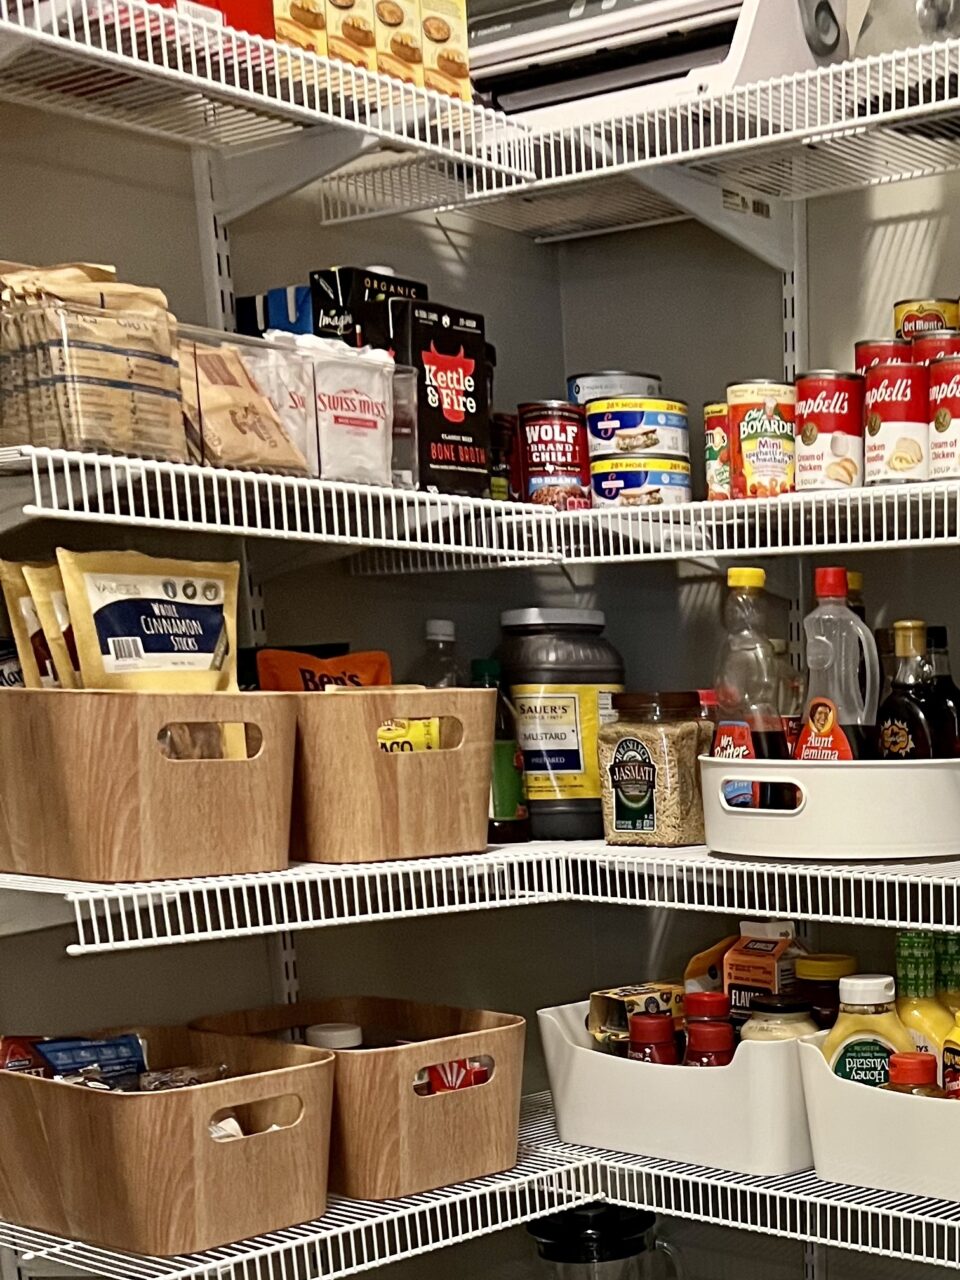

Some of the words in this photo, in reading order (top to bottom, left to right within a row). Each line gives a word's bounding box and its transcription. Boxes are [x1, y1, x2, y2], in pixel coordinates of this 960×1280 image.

[364, 277, 417, 299] ORGANIC
[916, 319, 943, 331] Monte
[424, 364, 475, 393] Kettle
[427, 386, 439, 408] &
[441, 388, 477, 414] Fire
[745, 408, 764, 421] Chef
[525, 424, 578, 444] WOLF
[530, 443, 574, 452] BRAND
[758, 439, 782, 450] Mini
[949, 439, 957, 449] of
[431, 442, 456, 461] BONE
[458, 444, 486, 464] BROTH
[531, 451, 573, 463] CHILI
[815, 452, 824, 462] of
[140, 615, 204, 636] CINNAMON
[170, 635, 199, 652] STICKS
[519, 703, 570, 715] SAUER'S
[523, 731, 568, 742] MUSTARD
[807, 731, 835, 748] Aunt
[800, 744, 839, 760] Jemima
[613, 764, 654, 782] JASMATI
[845, 1058, 889, 1071] Mustard
[850, 1070, 885, 1083] Honey
